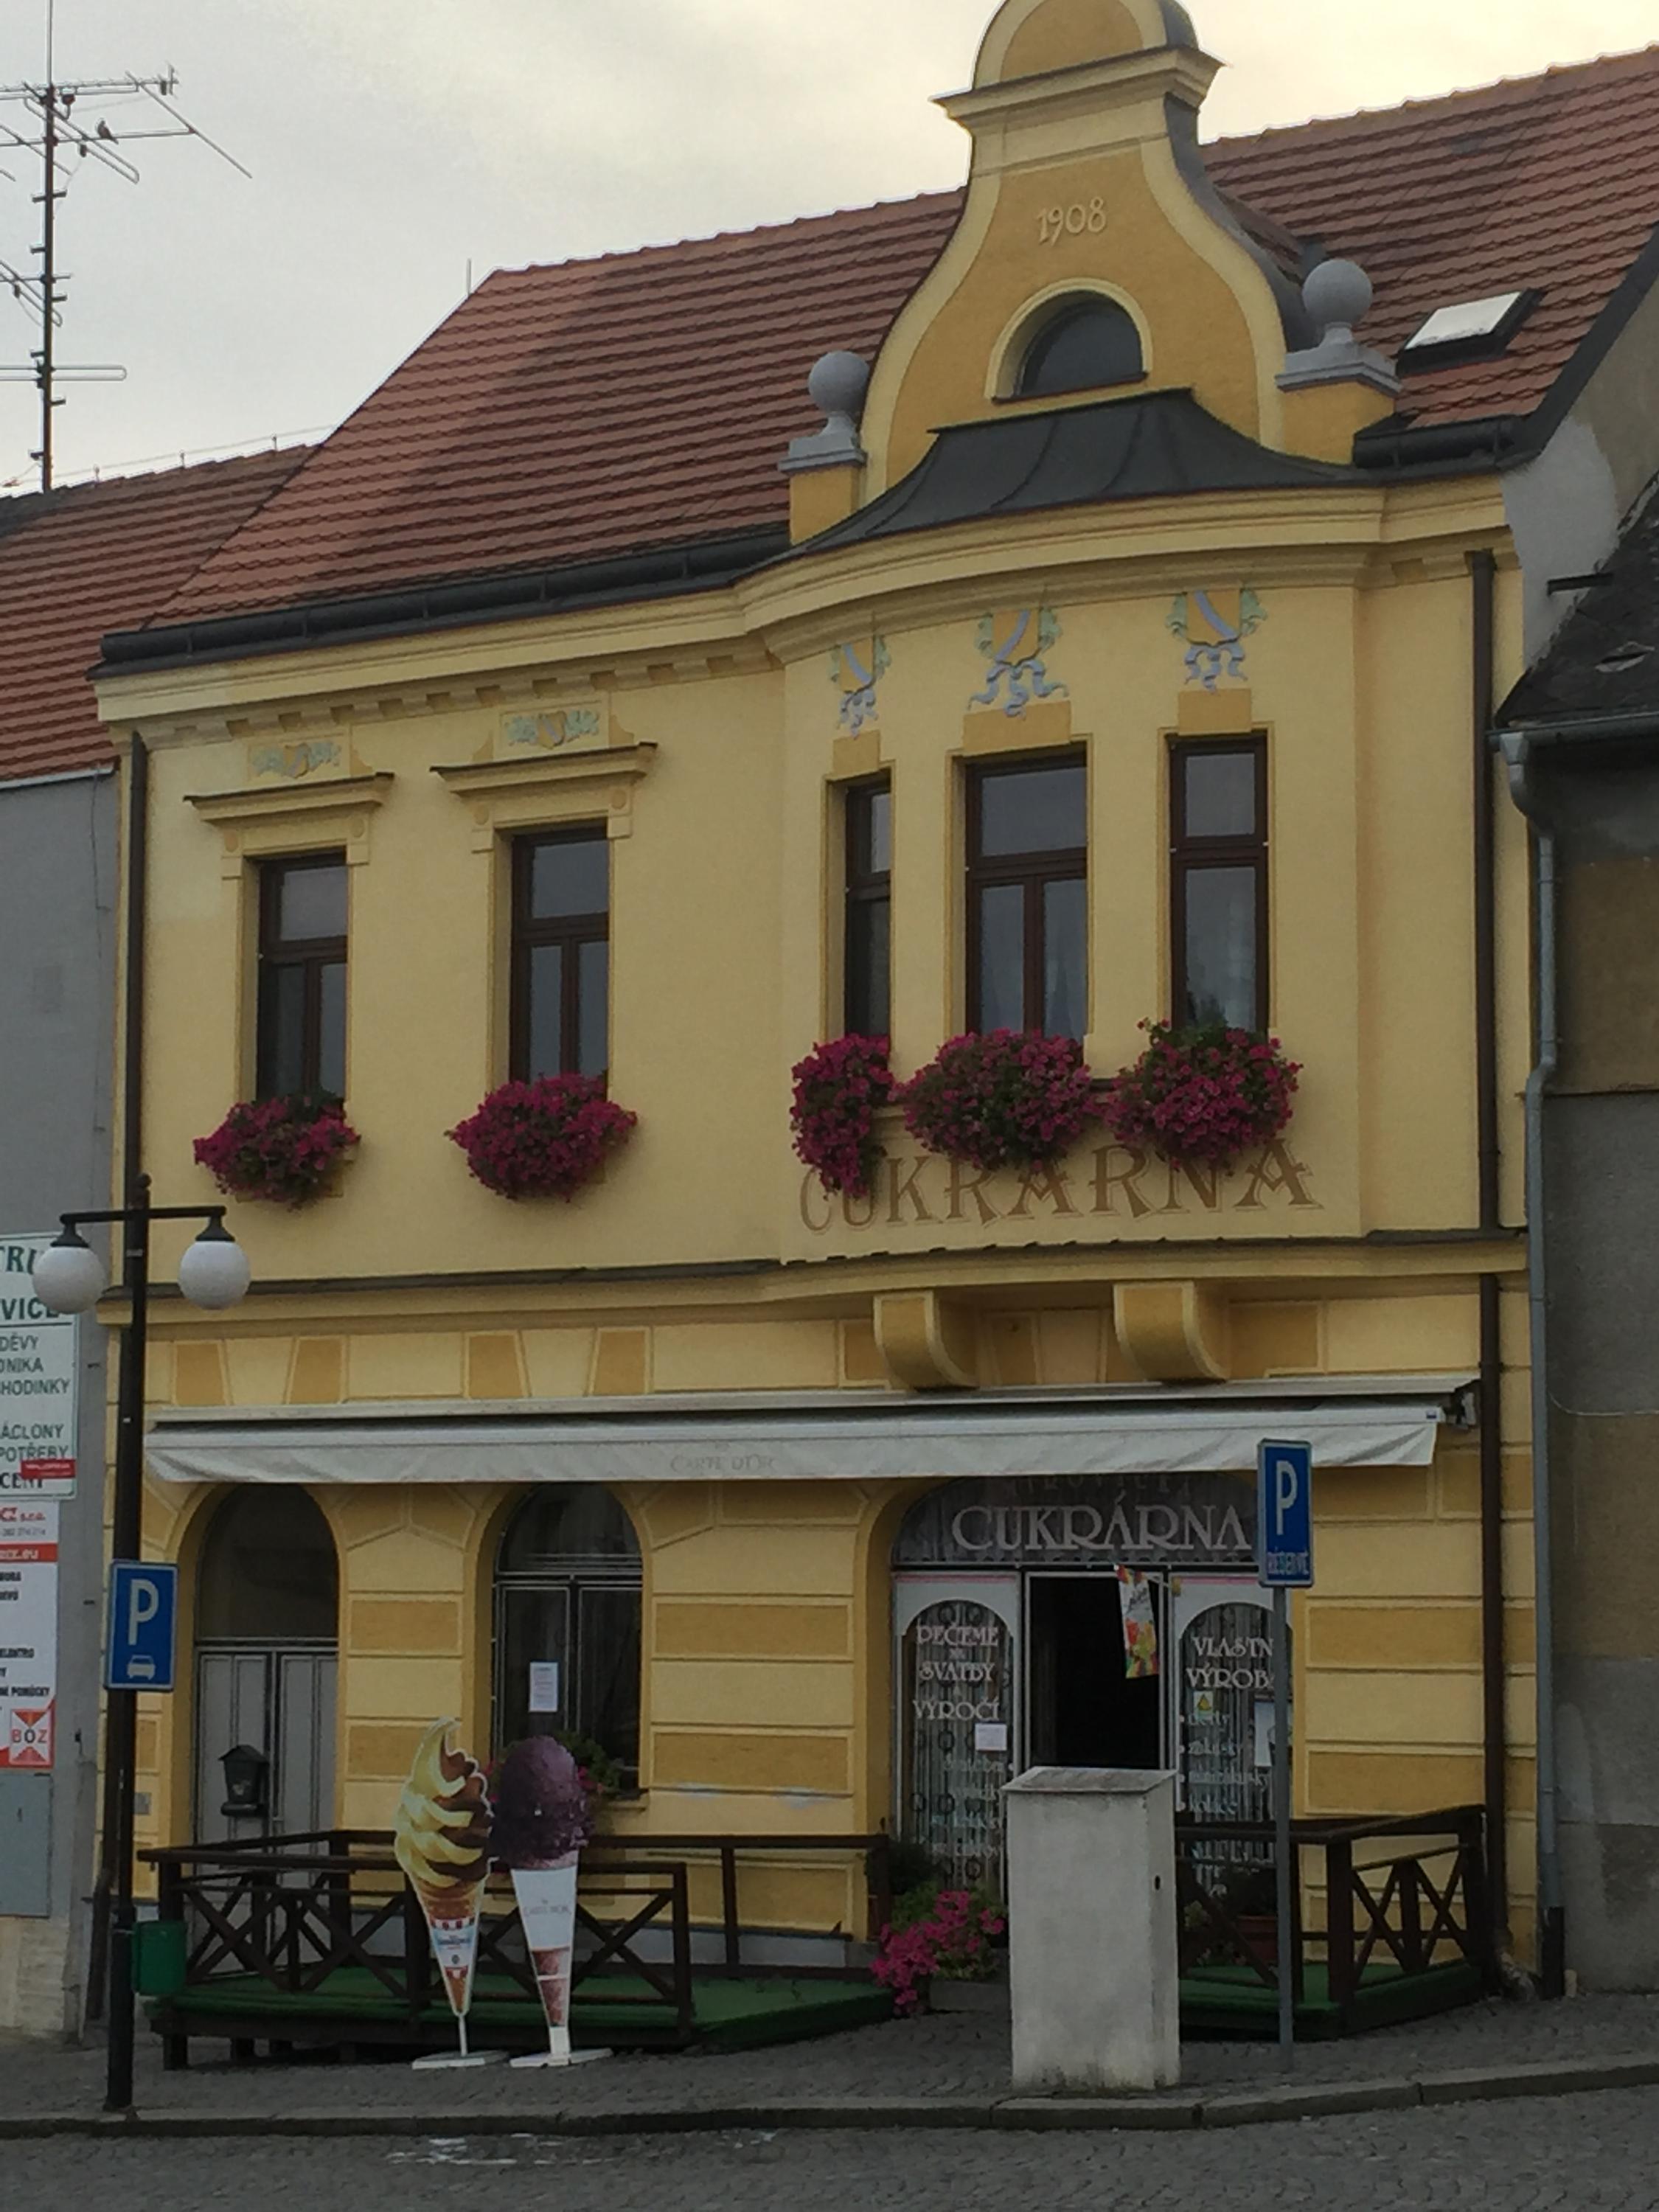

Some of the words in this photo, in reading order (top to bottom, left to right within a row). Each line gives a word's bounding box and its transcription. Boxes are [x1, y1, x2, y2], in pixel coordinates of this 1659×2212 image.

[1037, 195, 1106, 246] 1908
[1276, 1460, 1298, 1535] P
[952, 1491, 1252, 1551] CUKRÁRNA
[128, 1579, 159, 1645] P
[917, 1623, 998, 1646] PEČEME
[1193, 1636, 1274, 1658] VLASTN
[919, 1660, 995, 1681] SVATBY
[1186, 1664, 1275, 1689] VÝROB
[913, 1696, 1000, 1720] VÝROČÍ
[11, 1728, 47, 1744] BOZ
